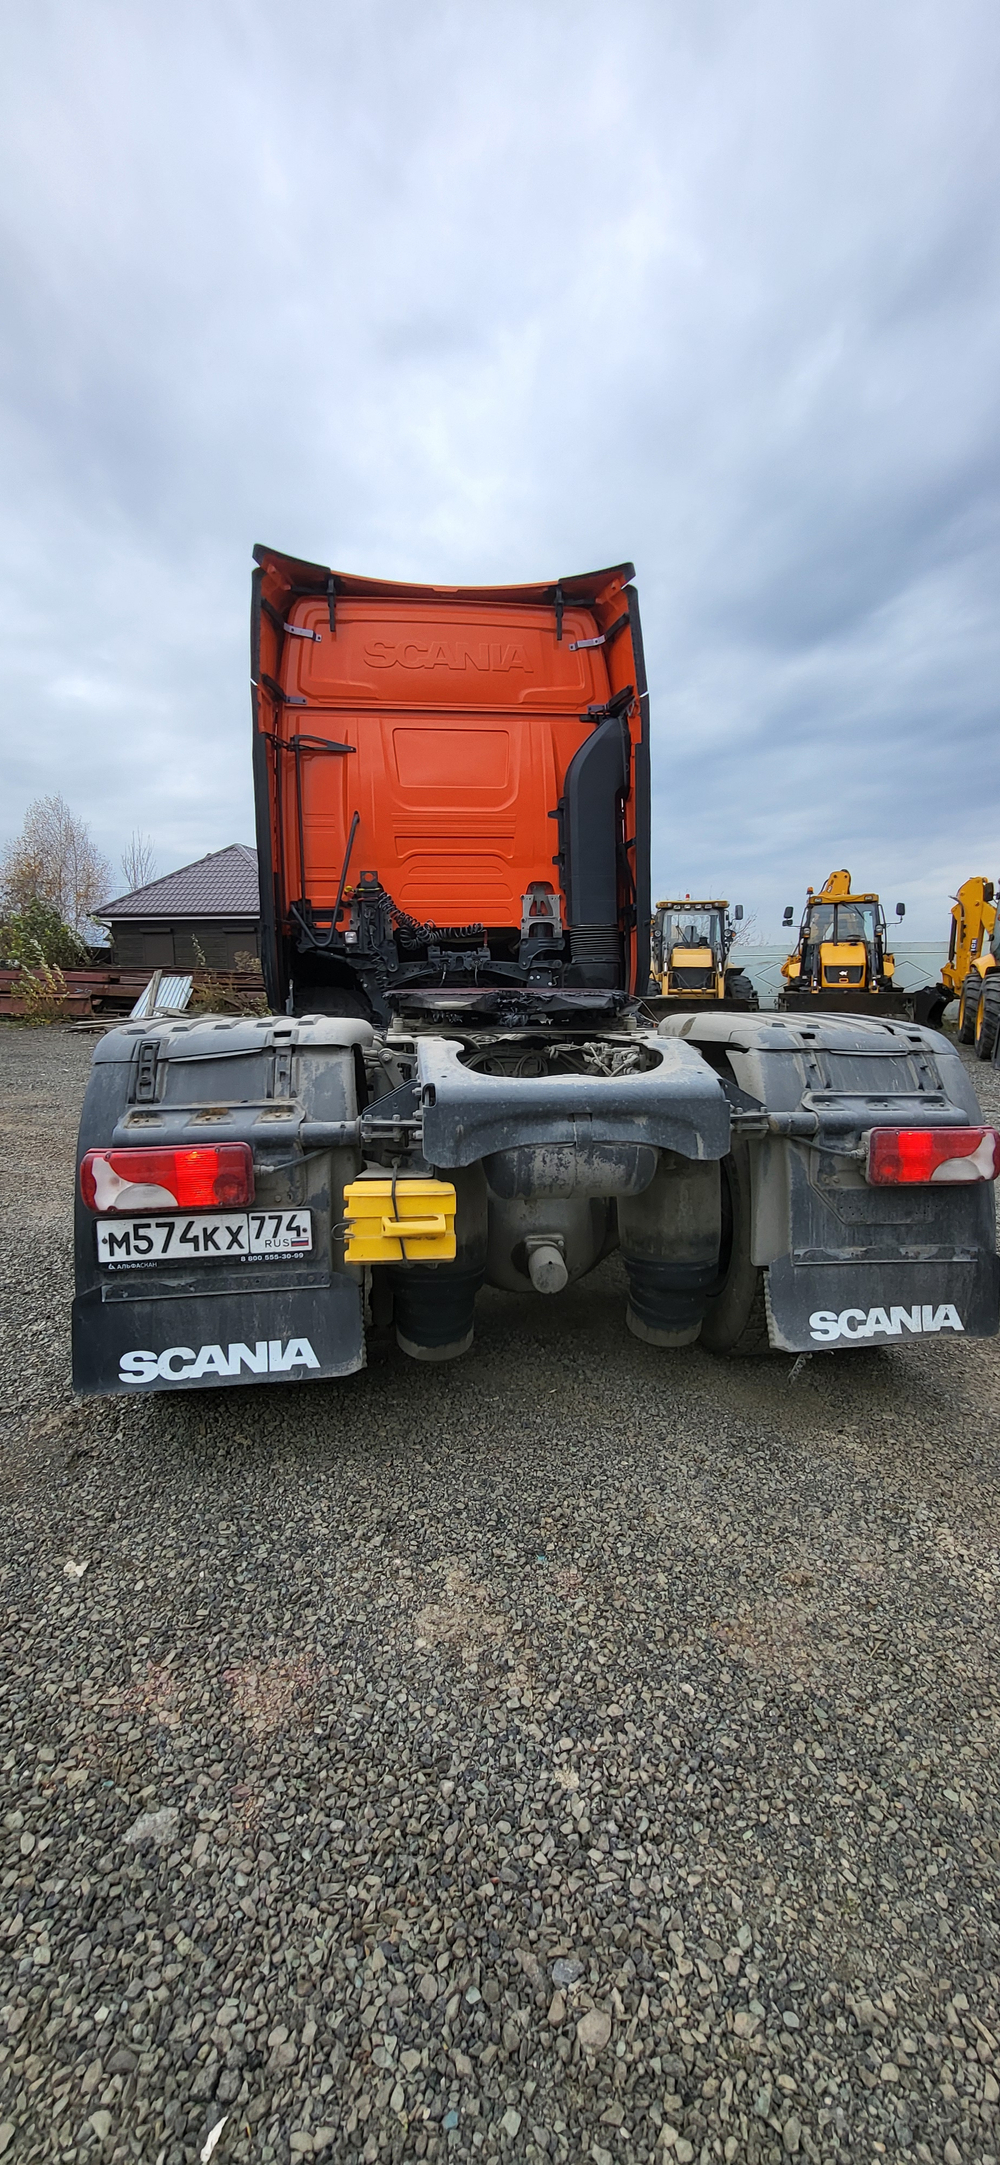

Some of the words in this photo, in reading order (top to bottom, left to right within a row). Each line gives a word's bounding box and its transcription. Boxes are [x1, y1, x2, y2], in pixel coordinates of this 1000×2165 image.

[363, 639, 534, 673] SCANIA
[250, 1214, 301, 1240] 774
[264, 1239, 290, 1248] RUS
[264, 1252, 304, 1261] 555-30-99
[117, 1262, 158, 1270] АЛЬФАСКАН
[808, 1304, 965, 1342] SCANIA
[118, 1337, 321, 1384] SCANIA
